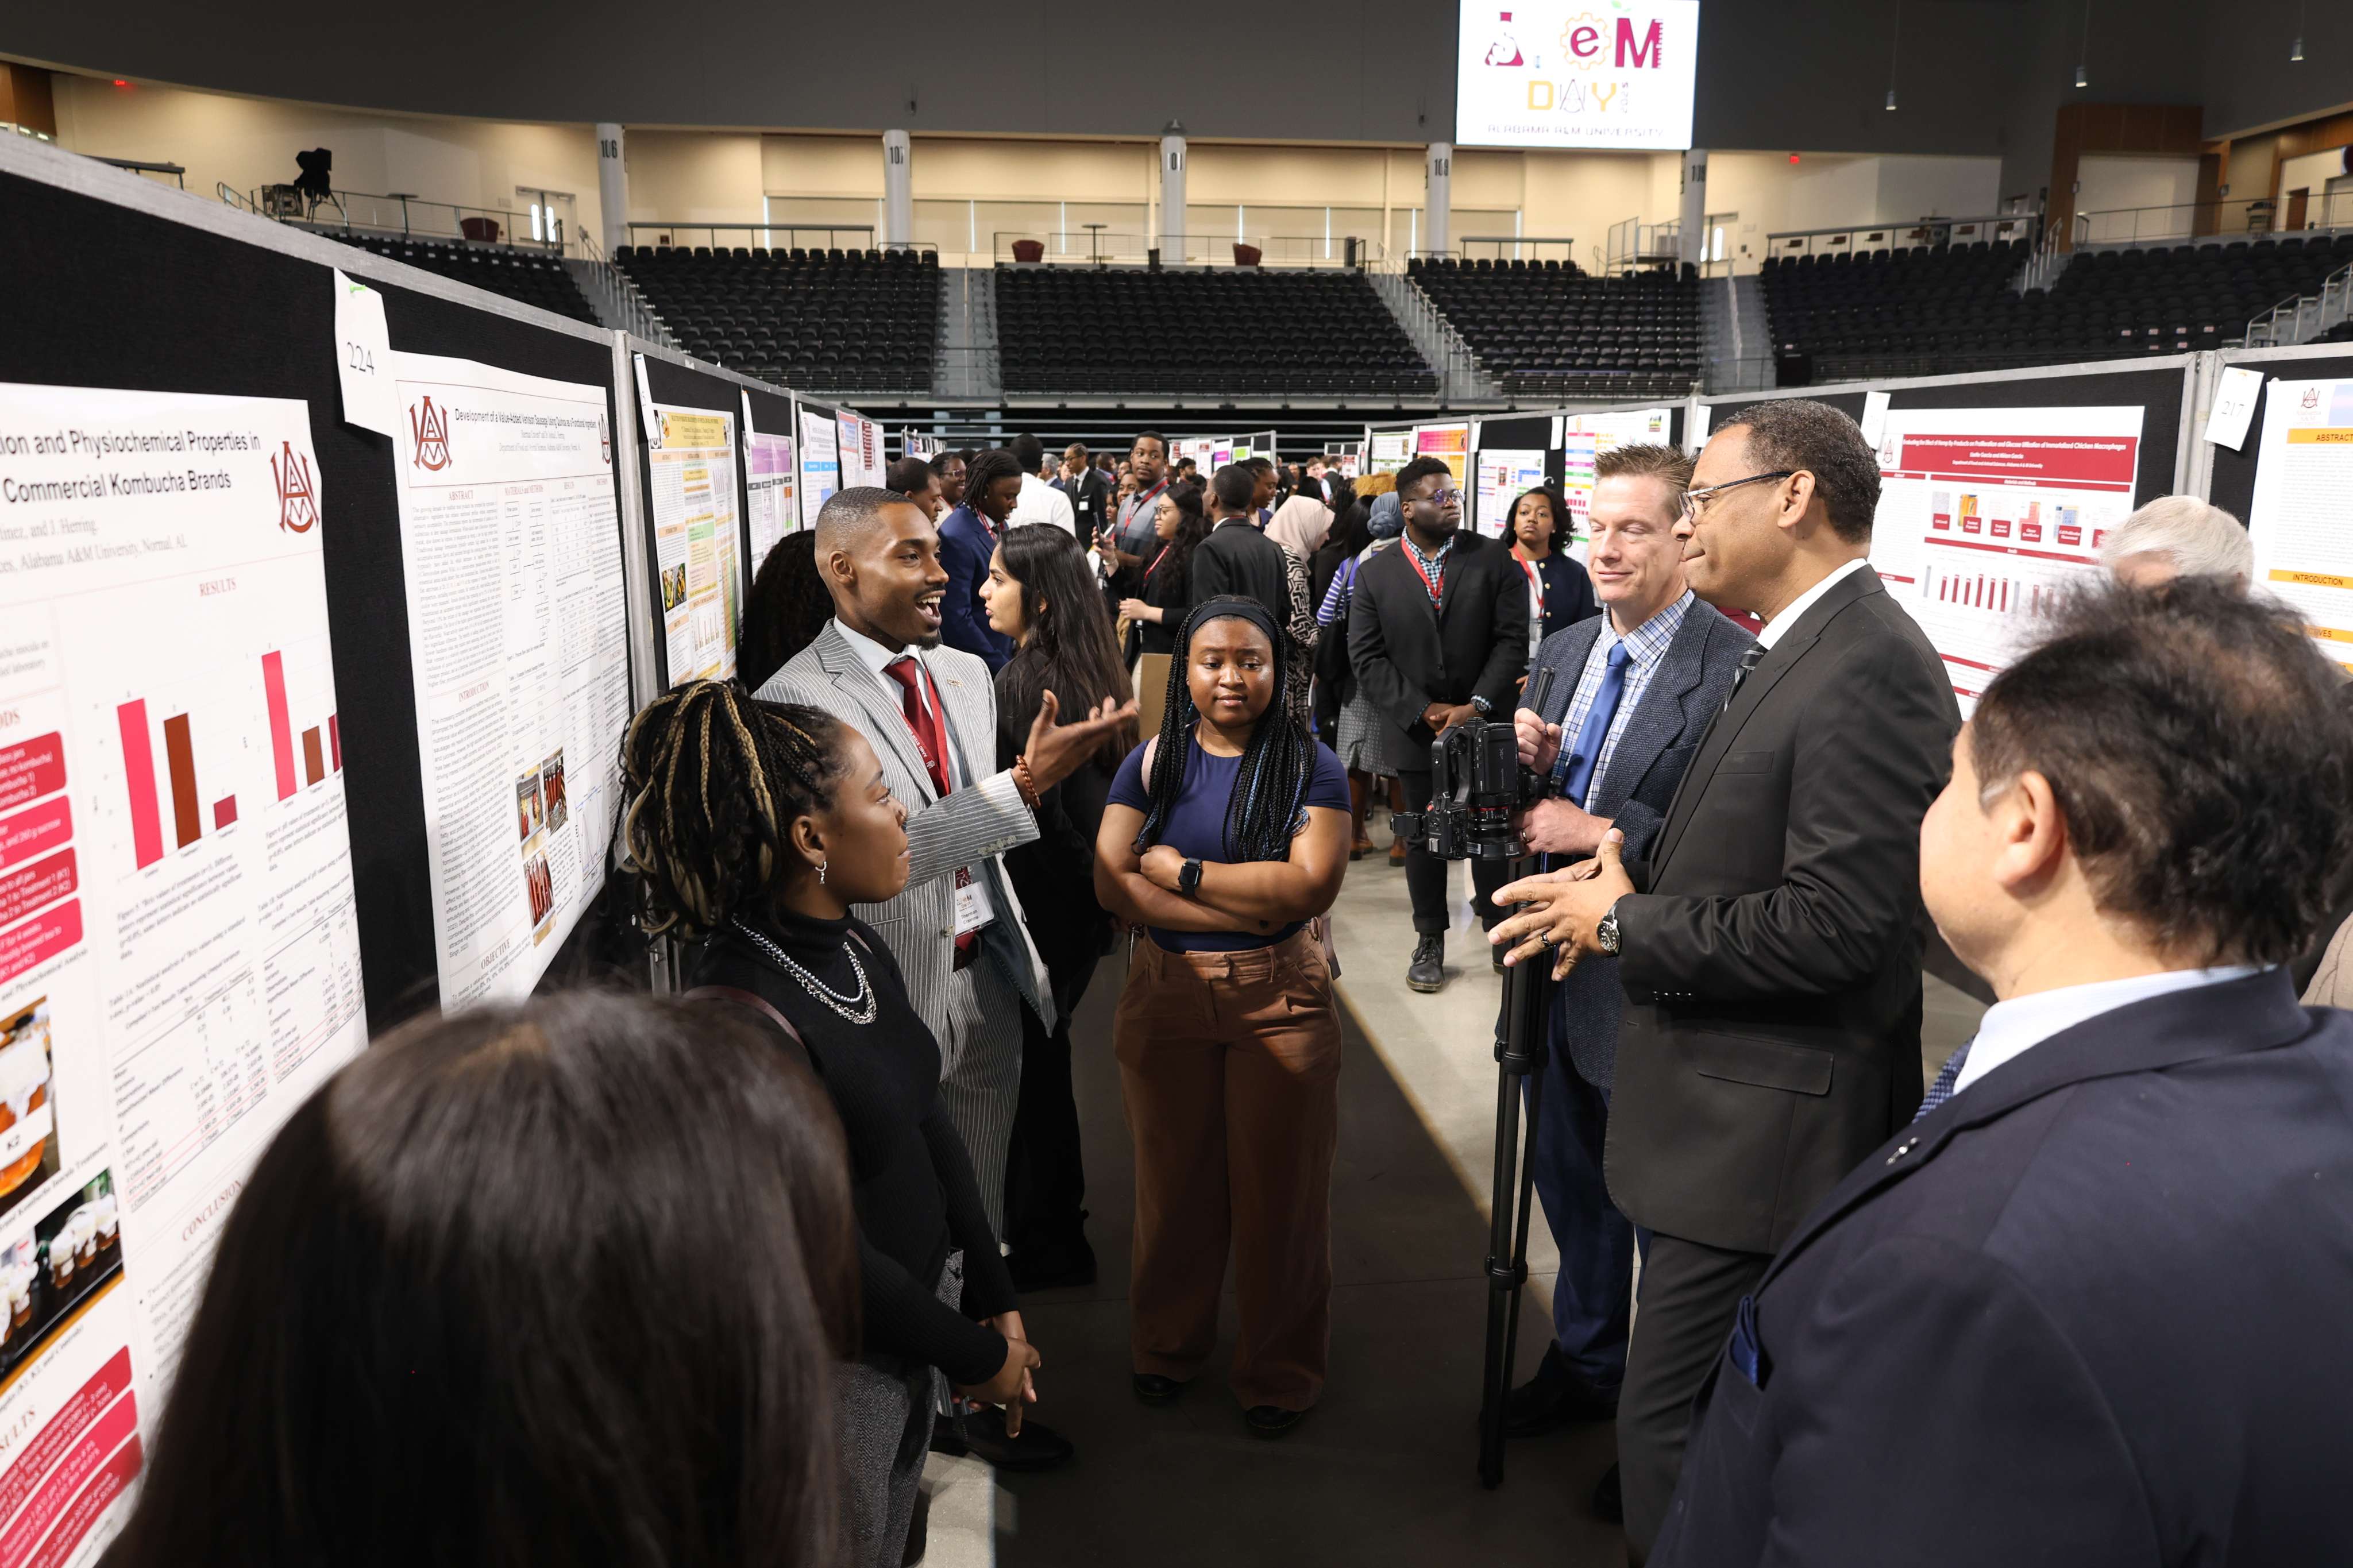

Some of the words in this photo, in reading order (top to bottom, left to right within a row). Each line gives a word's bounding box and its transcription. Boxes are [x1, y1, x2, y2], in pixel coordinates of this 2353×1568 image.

[1527, 79, 1617, 113] DAY
[1488, 124, 1549, 134] ALABAMA
[1554, 125, 1581, 136] A&M
[1586, 126, 1664, 138] UNIVERSITY
[601, 139, 618, 159] 106
[347, 342, 375, 375] 224
[455, 408, 488, 424] Development
[2220, 400, 2244, 417] 217
[34, 429, 67, 455] and
[69, 429, 186, 460] Physiochemical
[187, 430, 248, 456] Properties
[249, 430, 261, 450] in
[2093, 443, 2127, 451] Macrophages
[2316, 434, 2353, 442] ABSTRACT
[3, 472, 107, 504] Commercial
[109, 470, 185, 497] Kombucha
[186, 468, 232, 491] Brands
[448, 490, 474, 501] ABSTRACT
[30, 521, 49, 538] and
[21, 553, 64, 571] Alabama
[67, 546, 95, 564] A&M
[96, 542, 142, 559] University,
[199, 577, 237, 597] RESULTS
[2293, 573, 2343, 586] INTRODUCTION
[458, 680, 489, 702] INTRODUCTION
[20, 875, 51, 899] Treatment
[22, 888, 52, 911] Treatment
[481, 938, 511, 970] OBJECTIVE
[7, 1134, 21, 1150] K2
[183, 1179, 242, 1241] CONCLUSION
